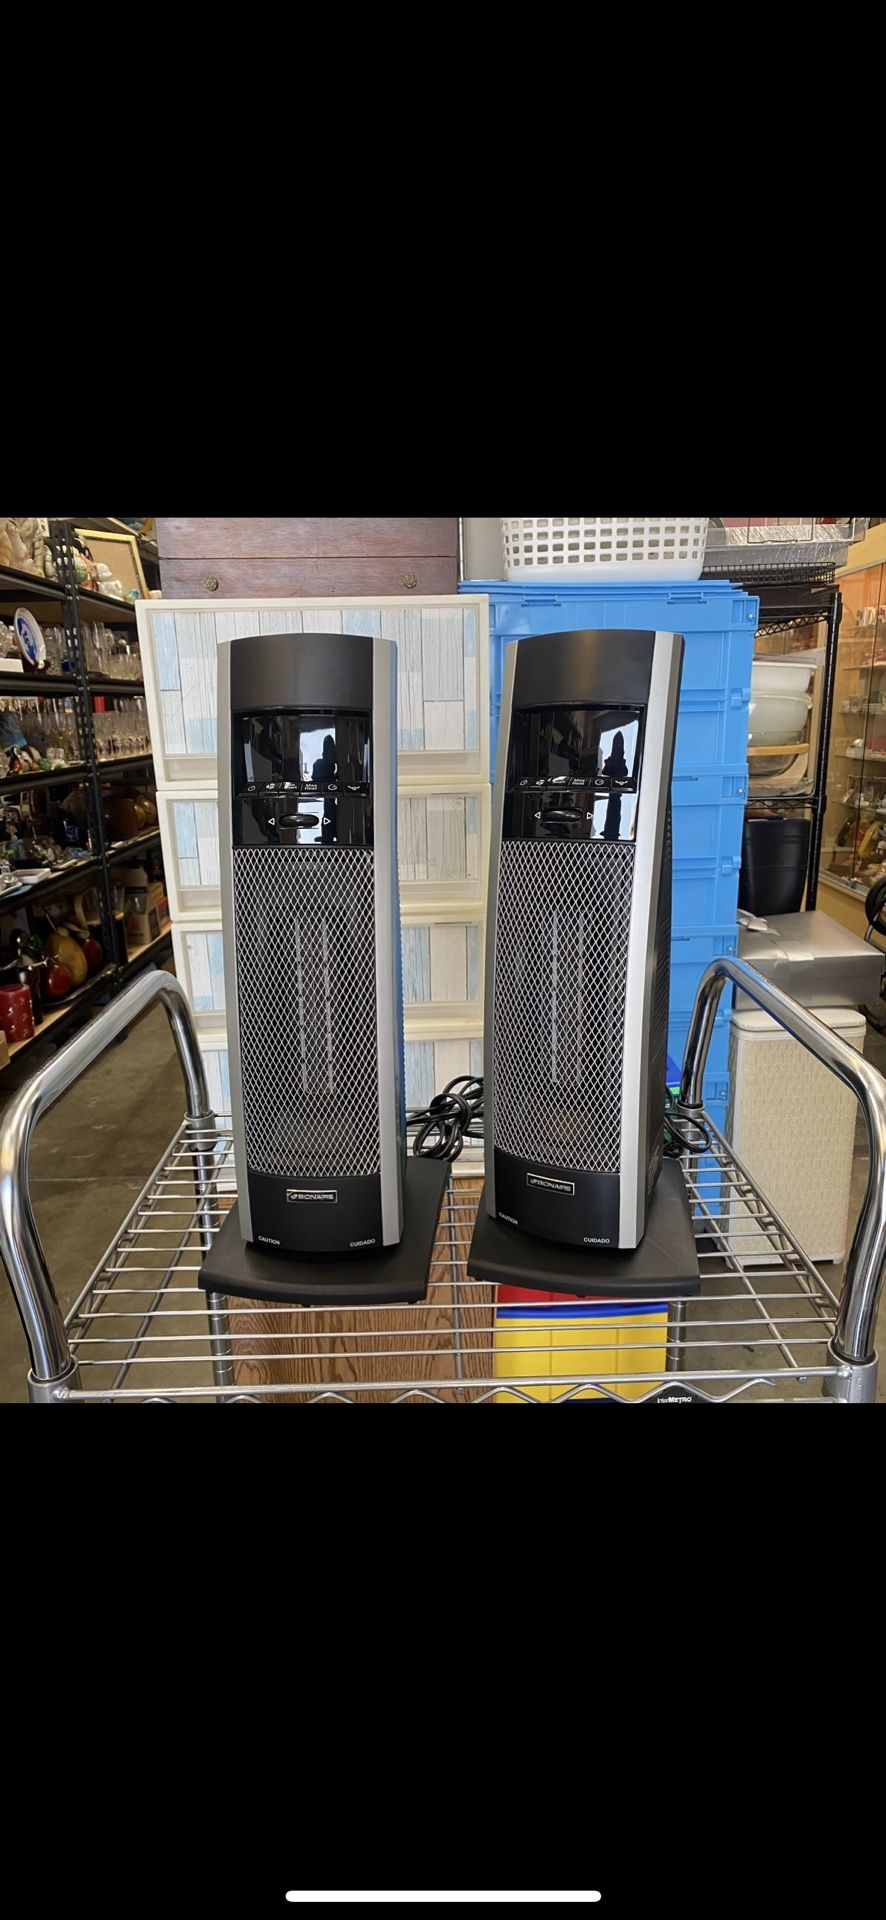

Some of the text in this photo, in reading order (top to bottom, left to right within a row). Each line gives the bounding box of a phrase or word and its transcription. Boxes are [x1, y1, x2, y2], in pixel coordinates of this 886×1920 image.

[537, 1180, 571, 1192] BIONAIRE
[498, 1212, 518, 1225] CAUTION
[258, 1235, 280, 1245] CAUTION
[350, 1238, 376, 1247] CUIDADO
